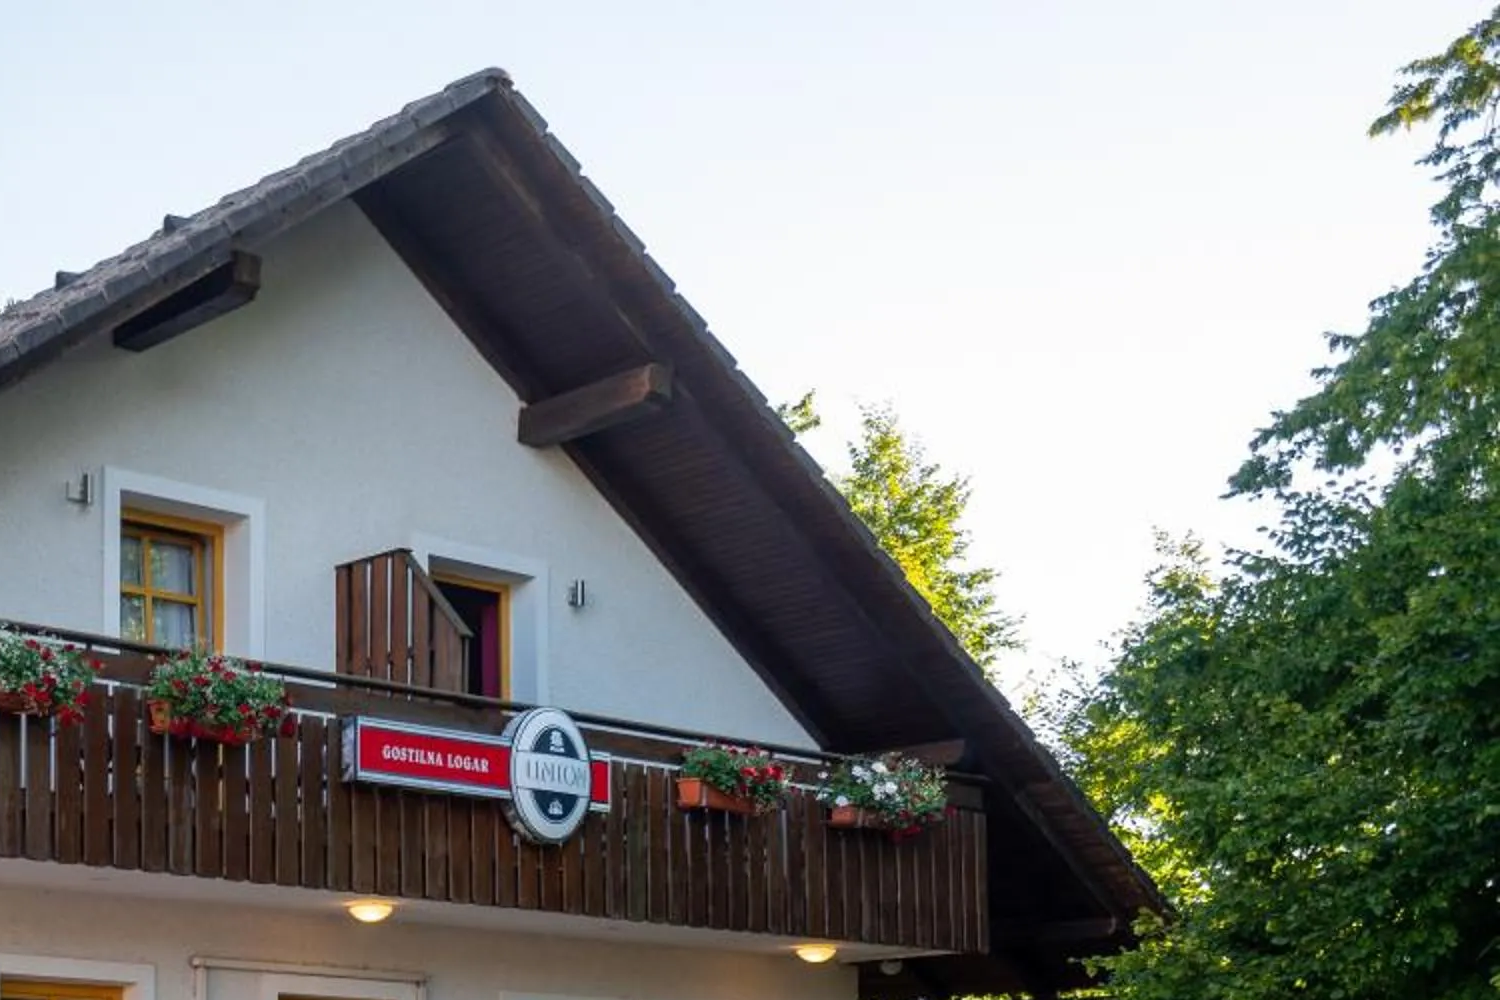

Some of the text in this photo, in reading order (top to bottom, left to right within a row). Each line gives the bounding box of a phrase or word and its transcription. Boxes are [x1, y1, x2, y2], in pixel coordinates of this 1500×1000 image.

[382, 744, 489, 773] GOSTILNA LOGAR
[525, 761, 587, 789] UNION
